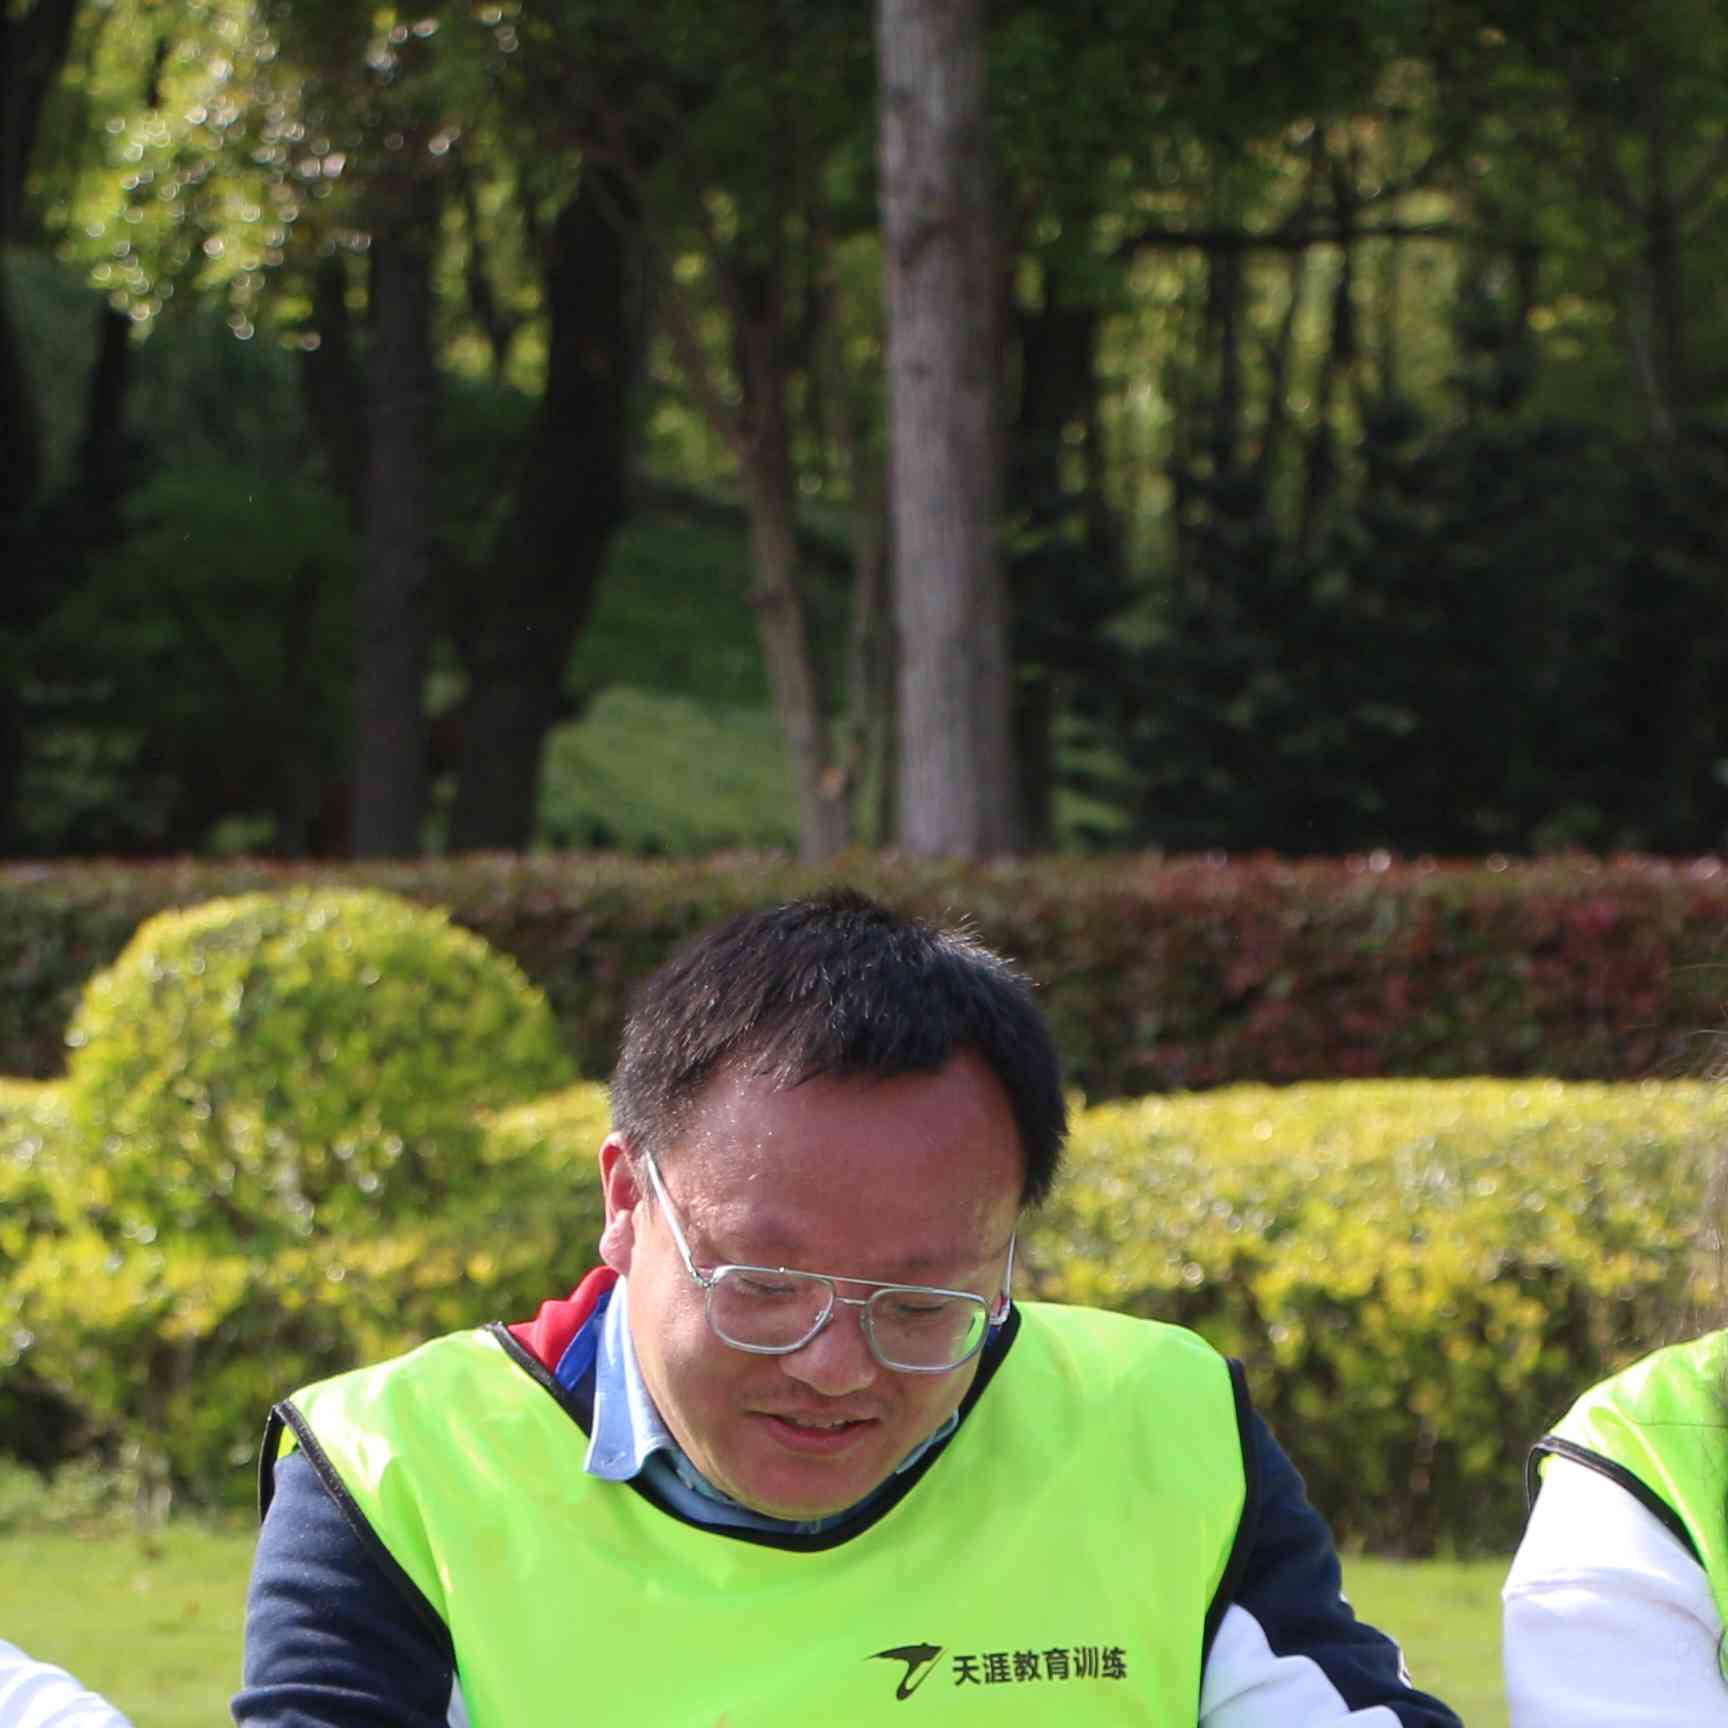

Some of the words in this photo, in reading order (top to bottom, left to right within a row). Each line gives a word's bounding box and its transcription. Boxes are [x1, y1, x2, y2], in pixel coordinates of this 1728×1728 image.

[952, 1646, 1127, 1686] 天涯教育训练
